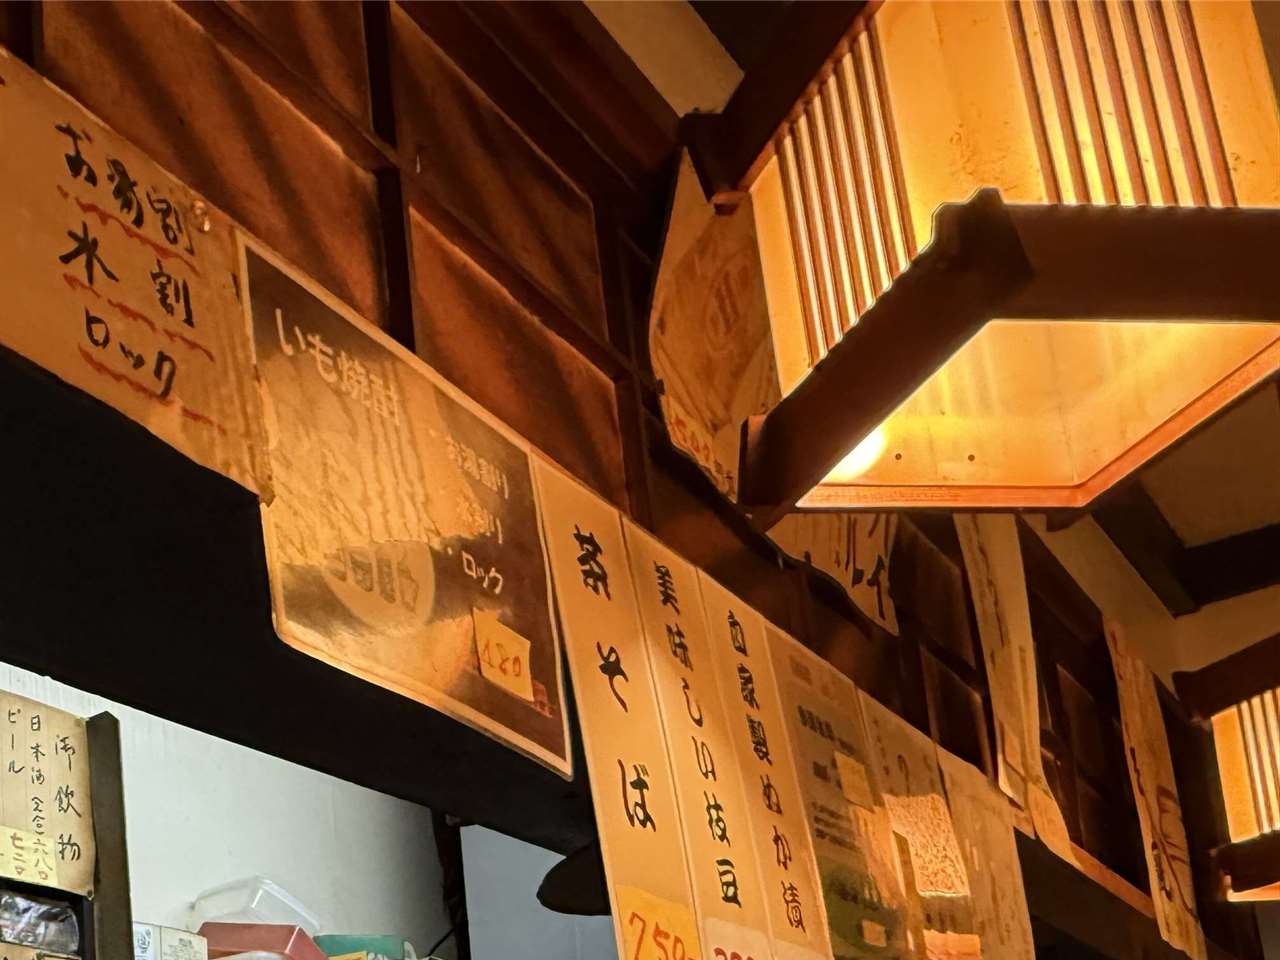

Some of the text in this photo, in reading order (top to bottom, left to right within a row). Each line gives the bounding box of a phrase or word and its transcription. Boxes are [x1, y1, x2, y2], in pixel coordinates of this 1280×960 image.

[57, 221, 196, 327] 水割
[84, 308, 176, 398] ロック
[275, 308, 400, 426] いも焼酎
[462, 551, 503, 594] ロック
[7, 708, 25, 774] ビール
[652, 560, 743, 909] 美味しい枝豆
[726, 610, 806, 934] 自家製ぬか漬
[54, 735, 82, 861] 御飲物
